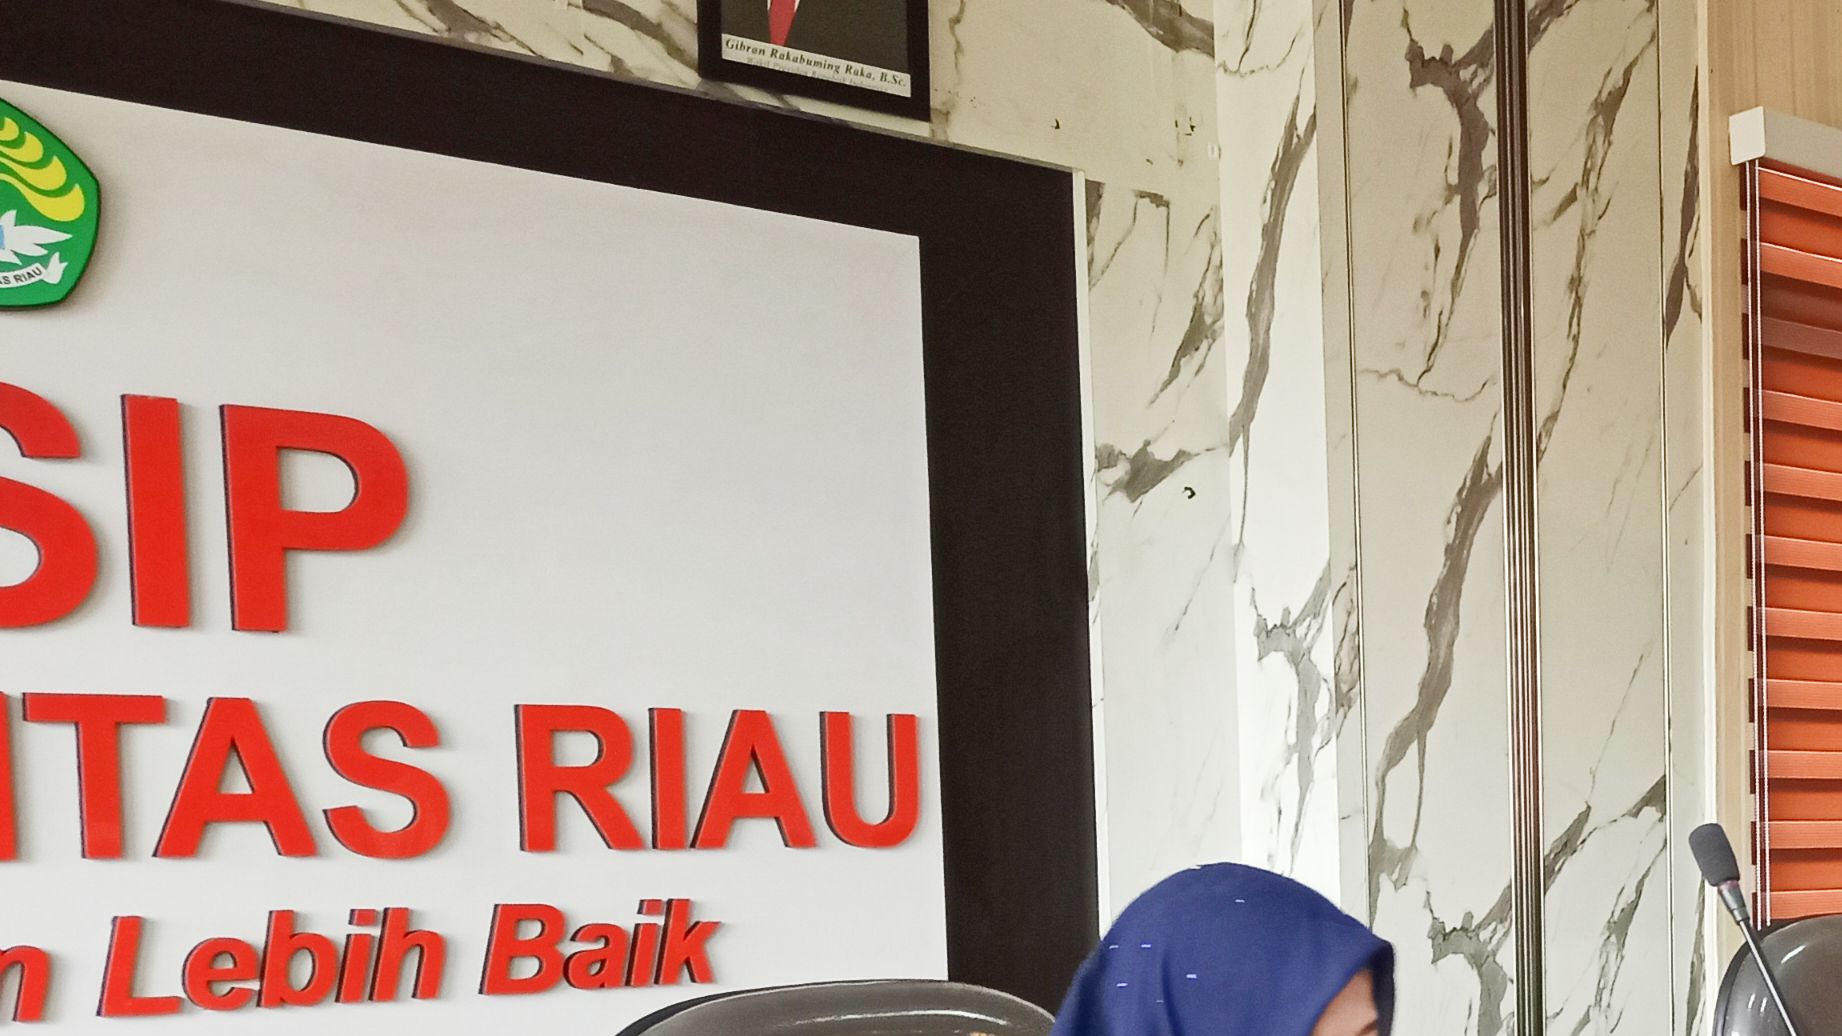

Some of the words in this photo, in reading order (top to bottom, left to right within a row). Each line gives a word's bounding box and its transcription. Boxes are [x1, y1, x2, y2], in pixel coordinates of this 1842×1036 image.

[725, 38, 770, 57] Gibran
[769, 47, 841, 75] Rakabuming
[879, 71, 907, 88] B.Sc.
[13, 266, 43, 284] RIAU
[514, 703, 921, 853] RIAU
[96, 906, 447, 1018] Lebih
[478, 898, 722, 996] Baik
